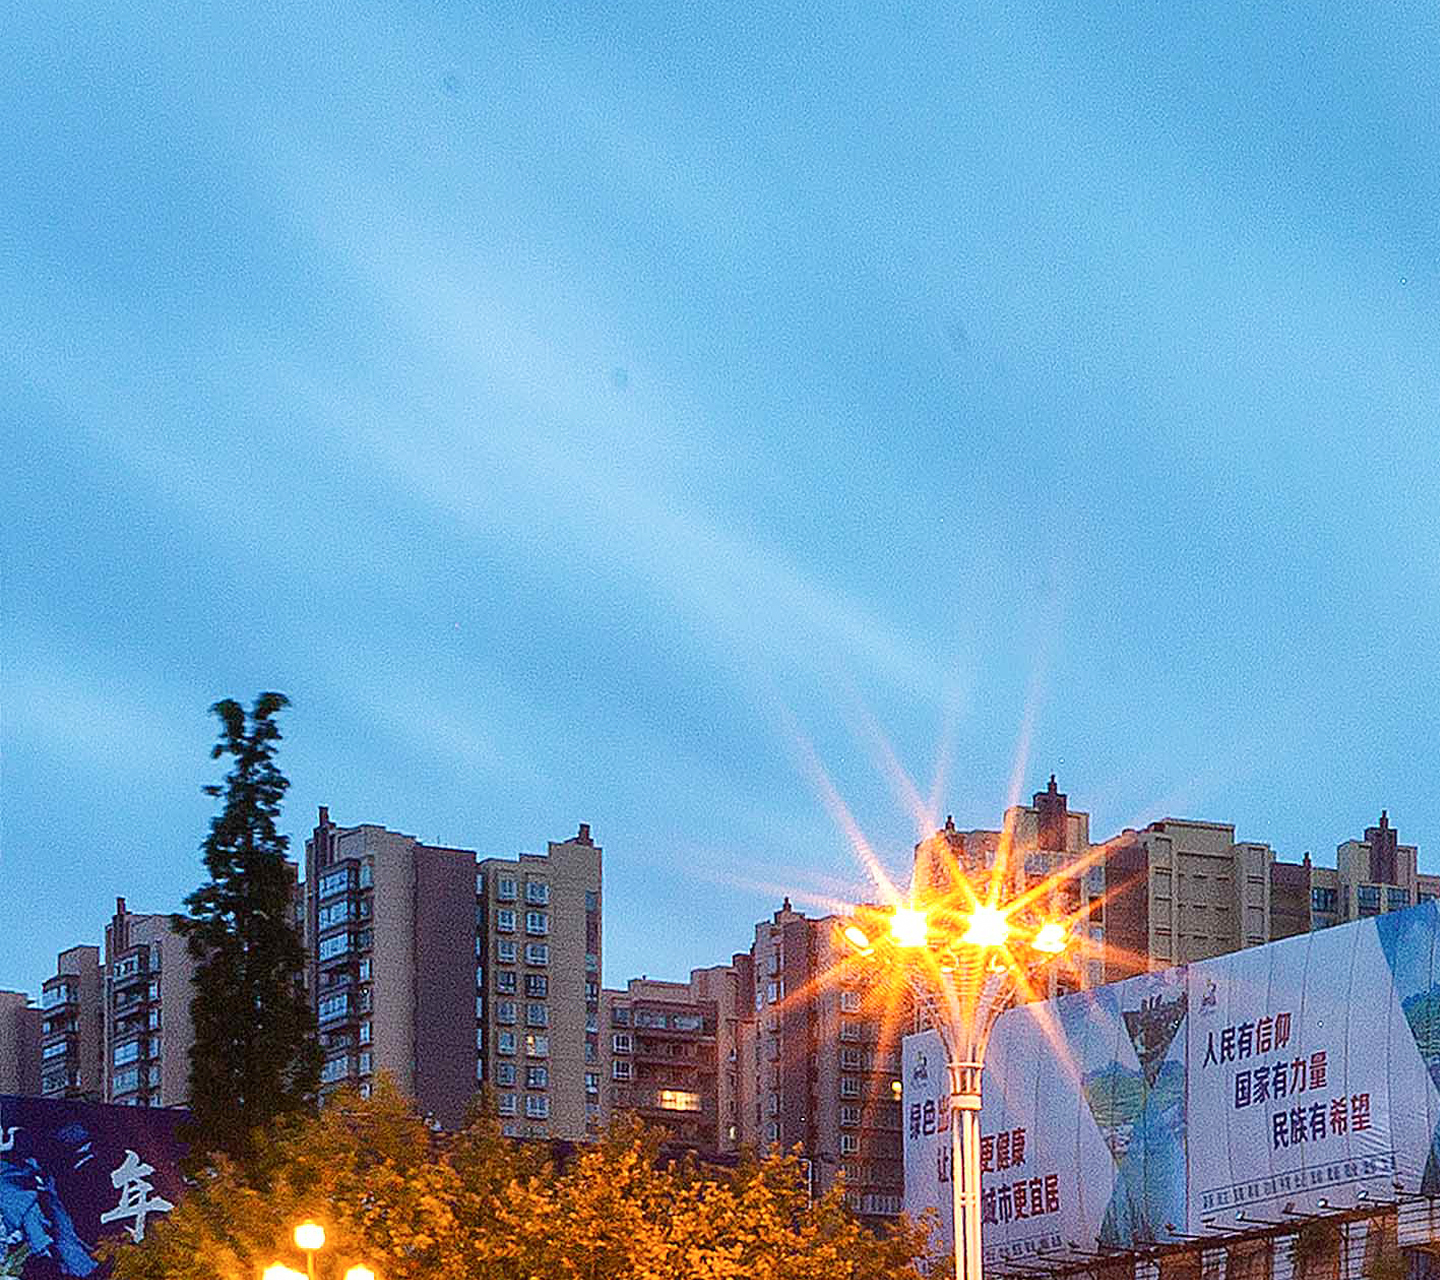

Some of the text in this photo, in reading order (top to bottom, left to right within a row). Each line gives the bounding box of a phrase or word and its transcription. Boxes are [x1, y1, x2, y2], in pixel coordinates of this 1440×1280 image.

[1203, 1013, 1291, 1069] 人民有信仰
[1235, 1051, 1327, 1109] 国家有力量
[1273, 1093, 1371, 1150] 民族有希望
